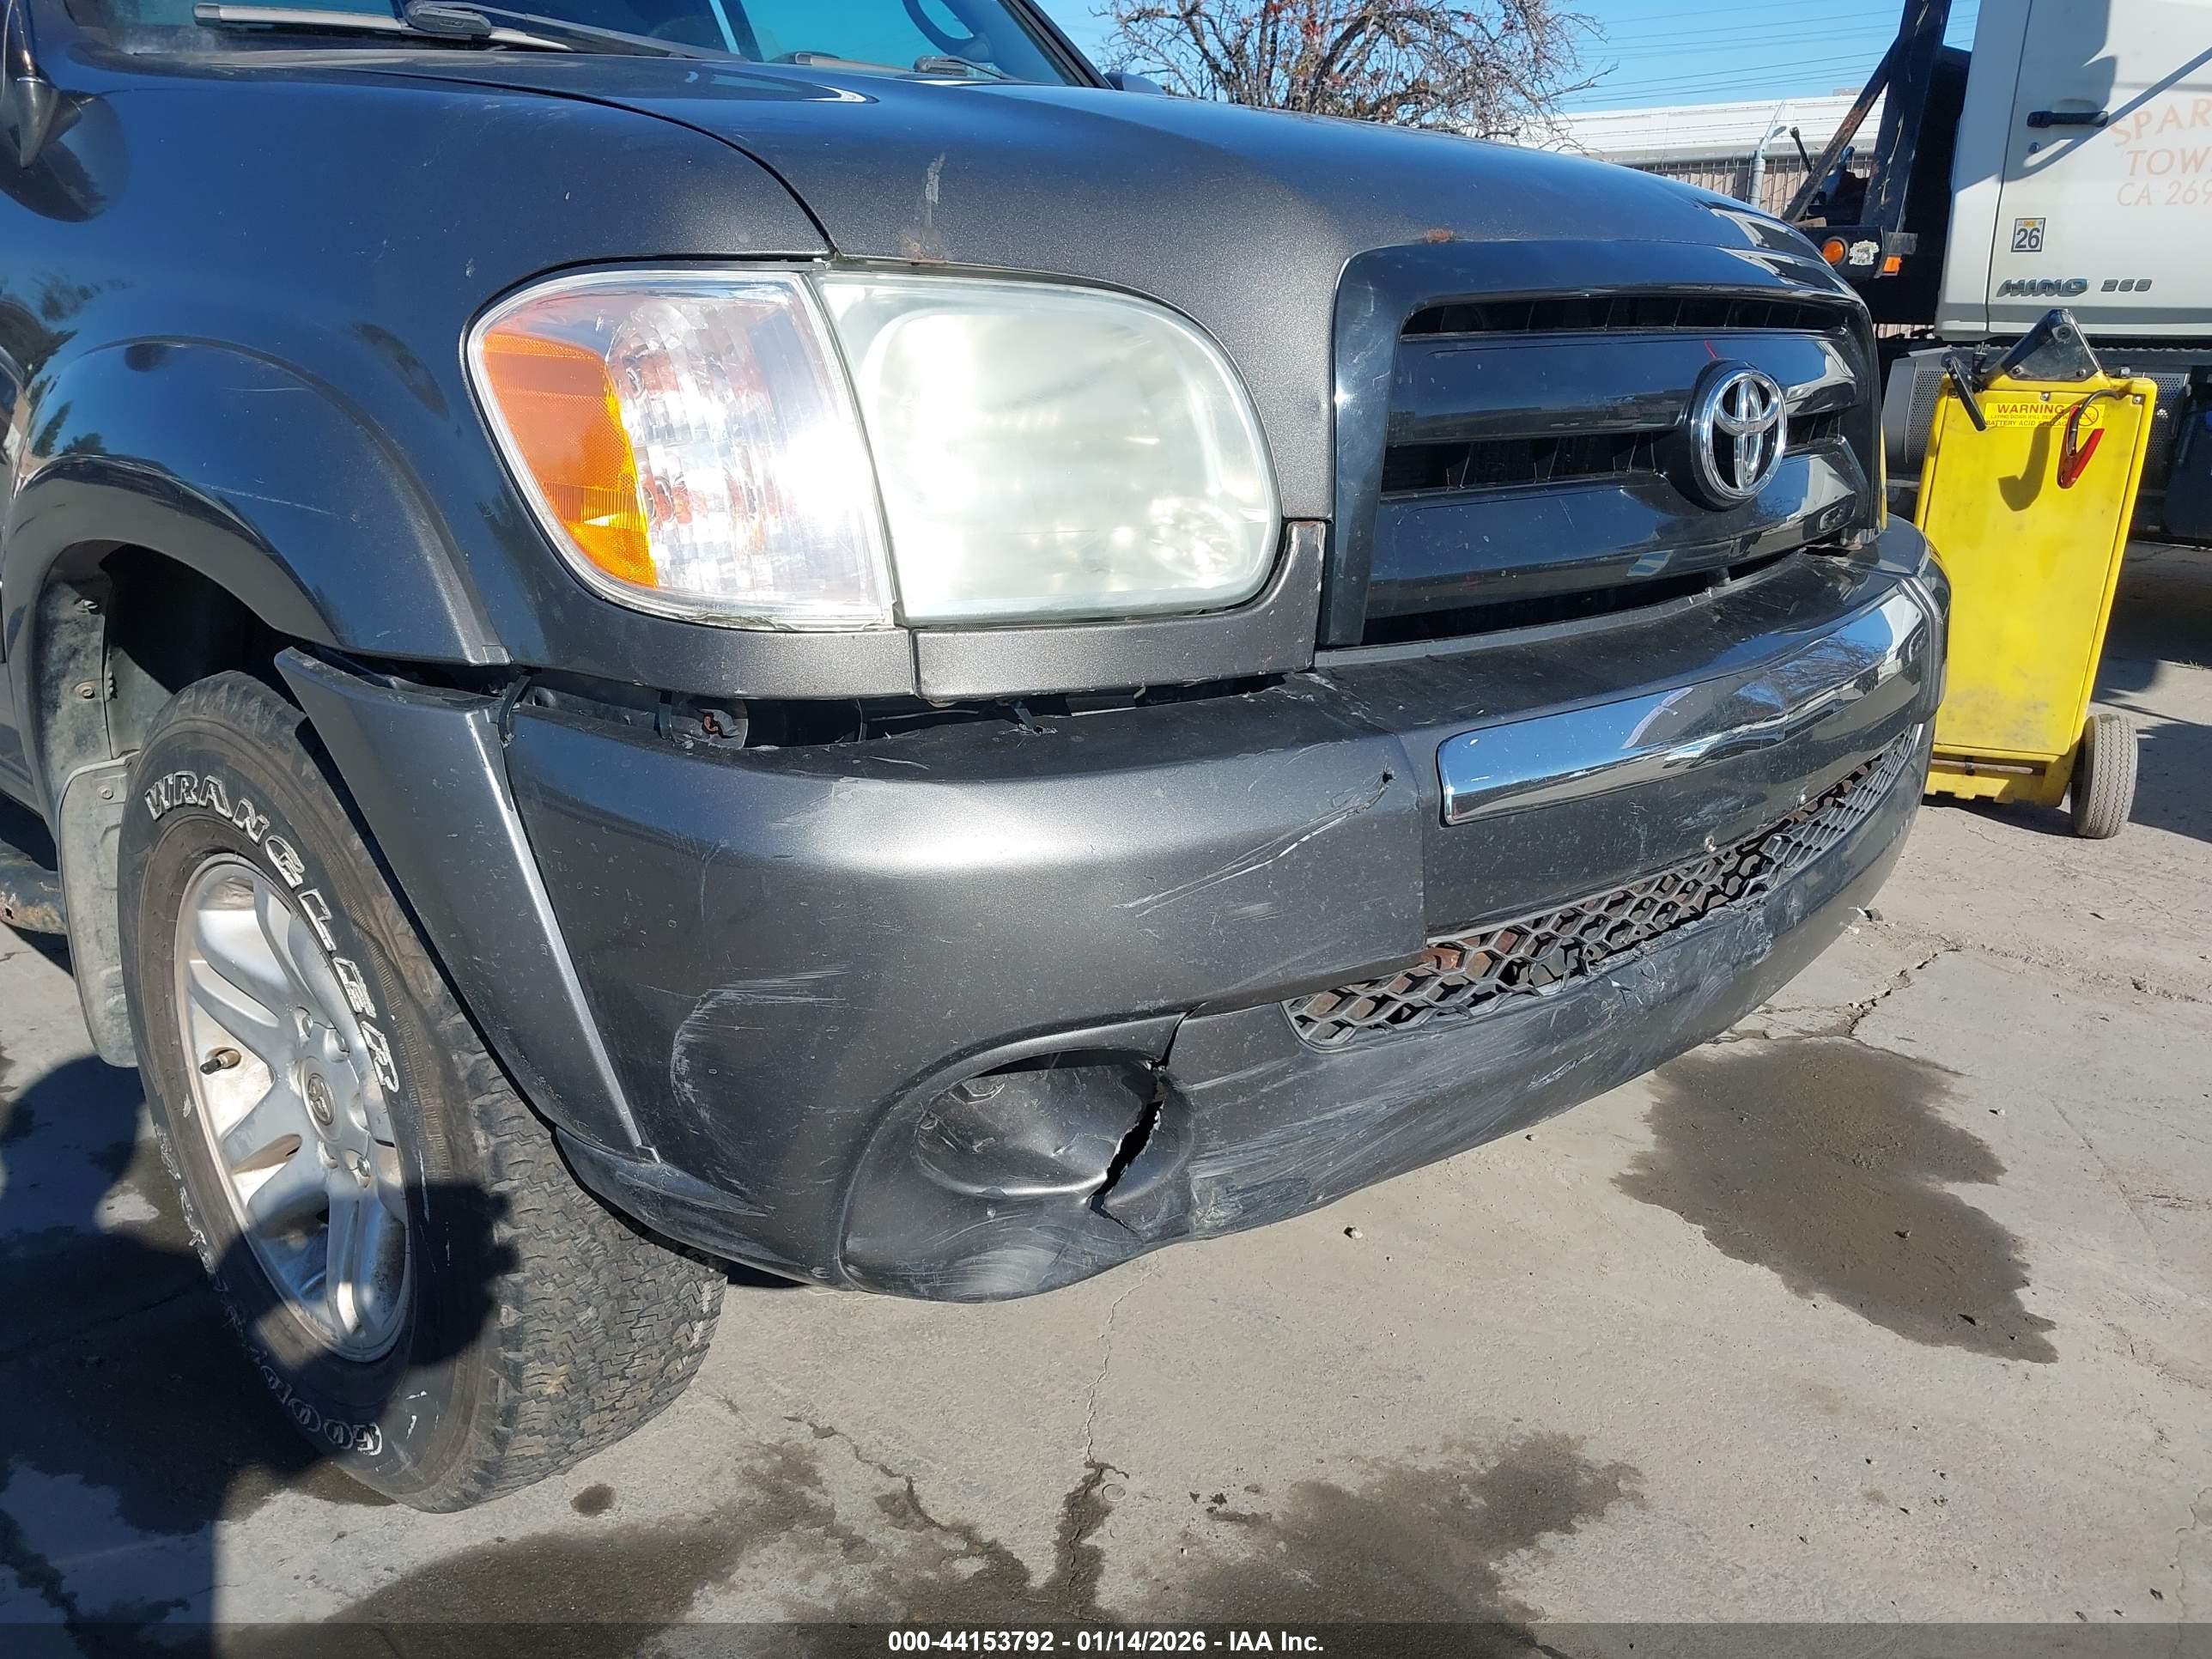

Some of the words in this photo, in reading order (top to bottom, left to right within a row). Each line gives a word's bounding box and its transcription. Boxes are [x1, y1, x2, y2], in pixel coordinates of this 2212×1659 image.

[2117, 181, 2152, 206] CA
[2014, 227, 2040, 249] 26
[1996, 404, 2064, 414] WARNING
[144, 770, 400, 1093] WRANGLER
